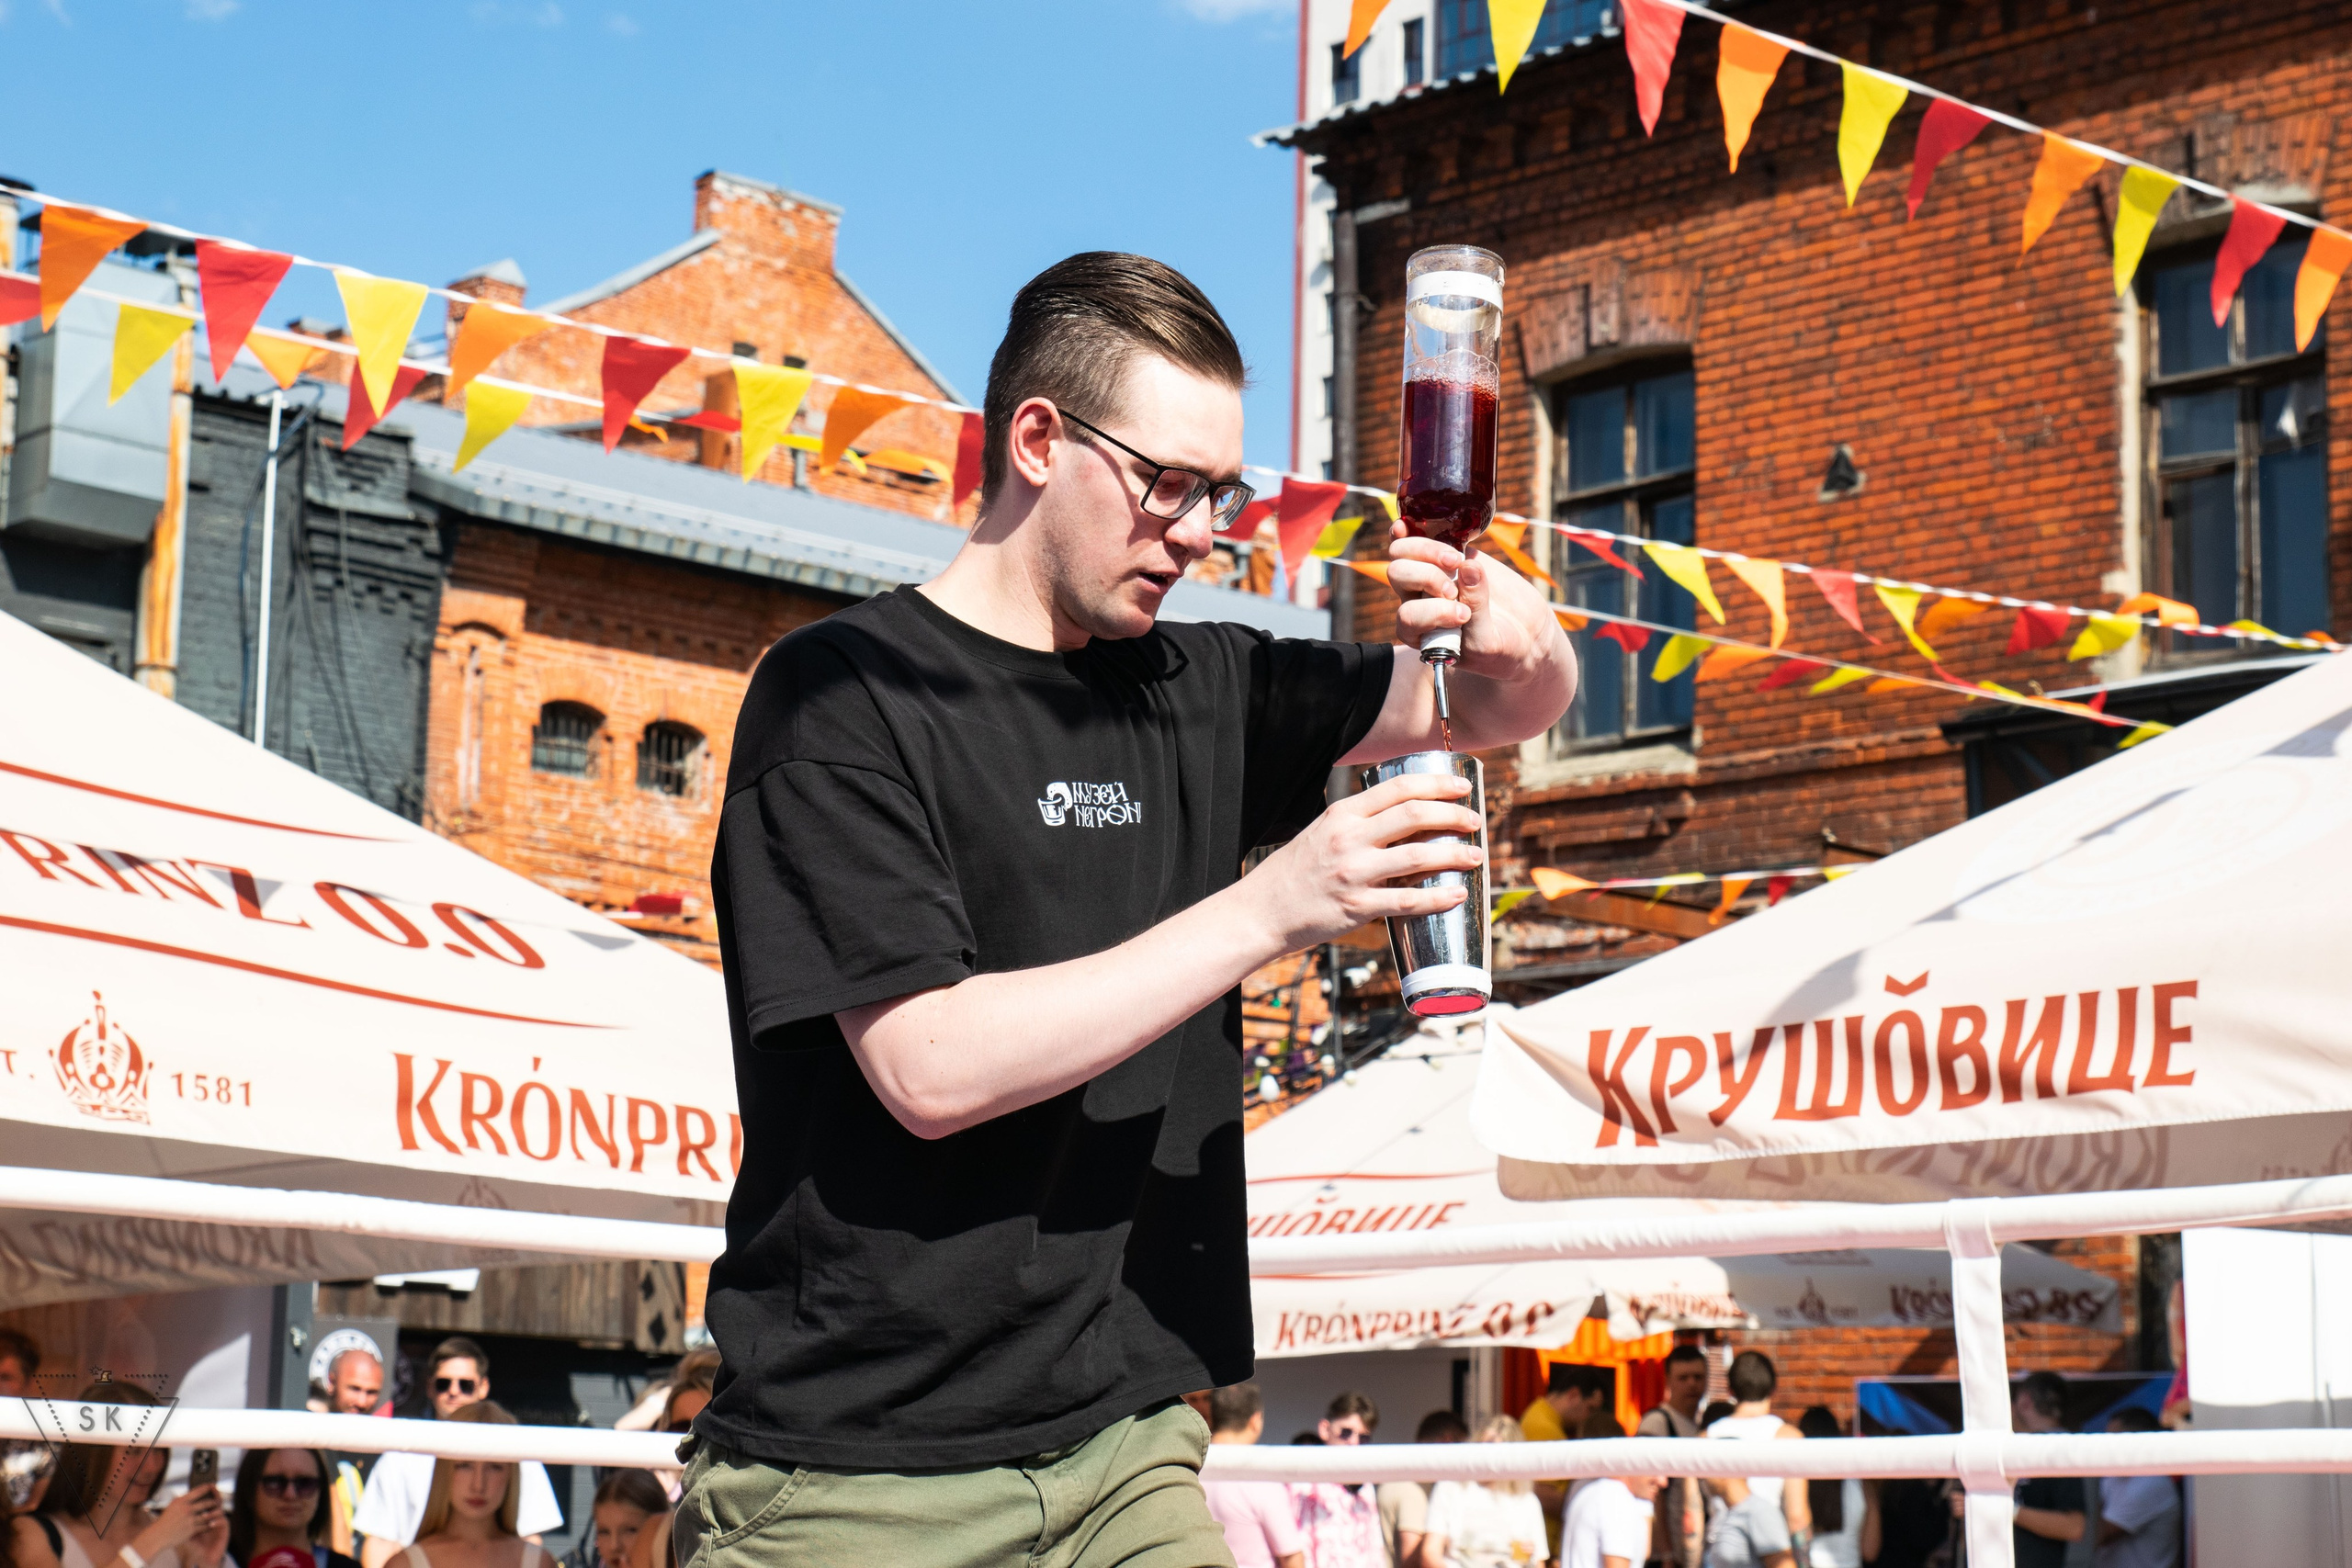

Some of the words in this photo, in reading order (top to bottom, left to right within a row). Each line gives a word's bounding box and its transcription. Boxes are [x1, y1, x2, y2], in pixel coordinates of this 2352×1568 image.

[1071, 782, 1128, 805] МУЗЕЙ
[313, 881, 546, 969] 0.0
[171, 1072, 252, 1107] 1581
